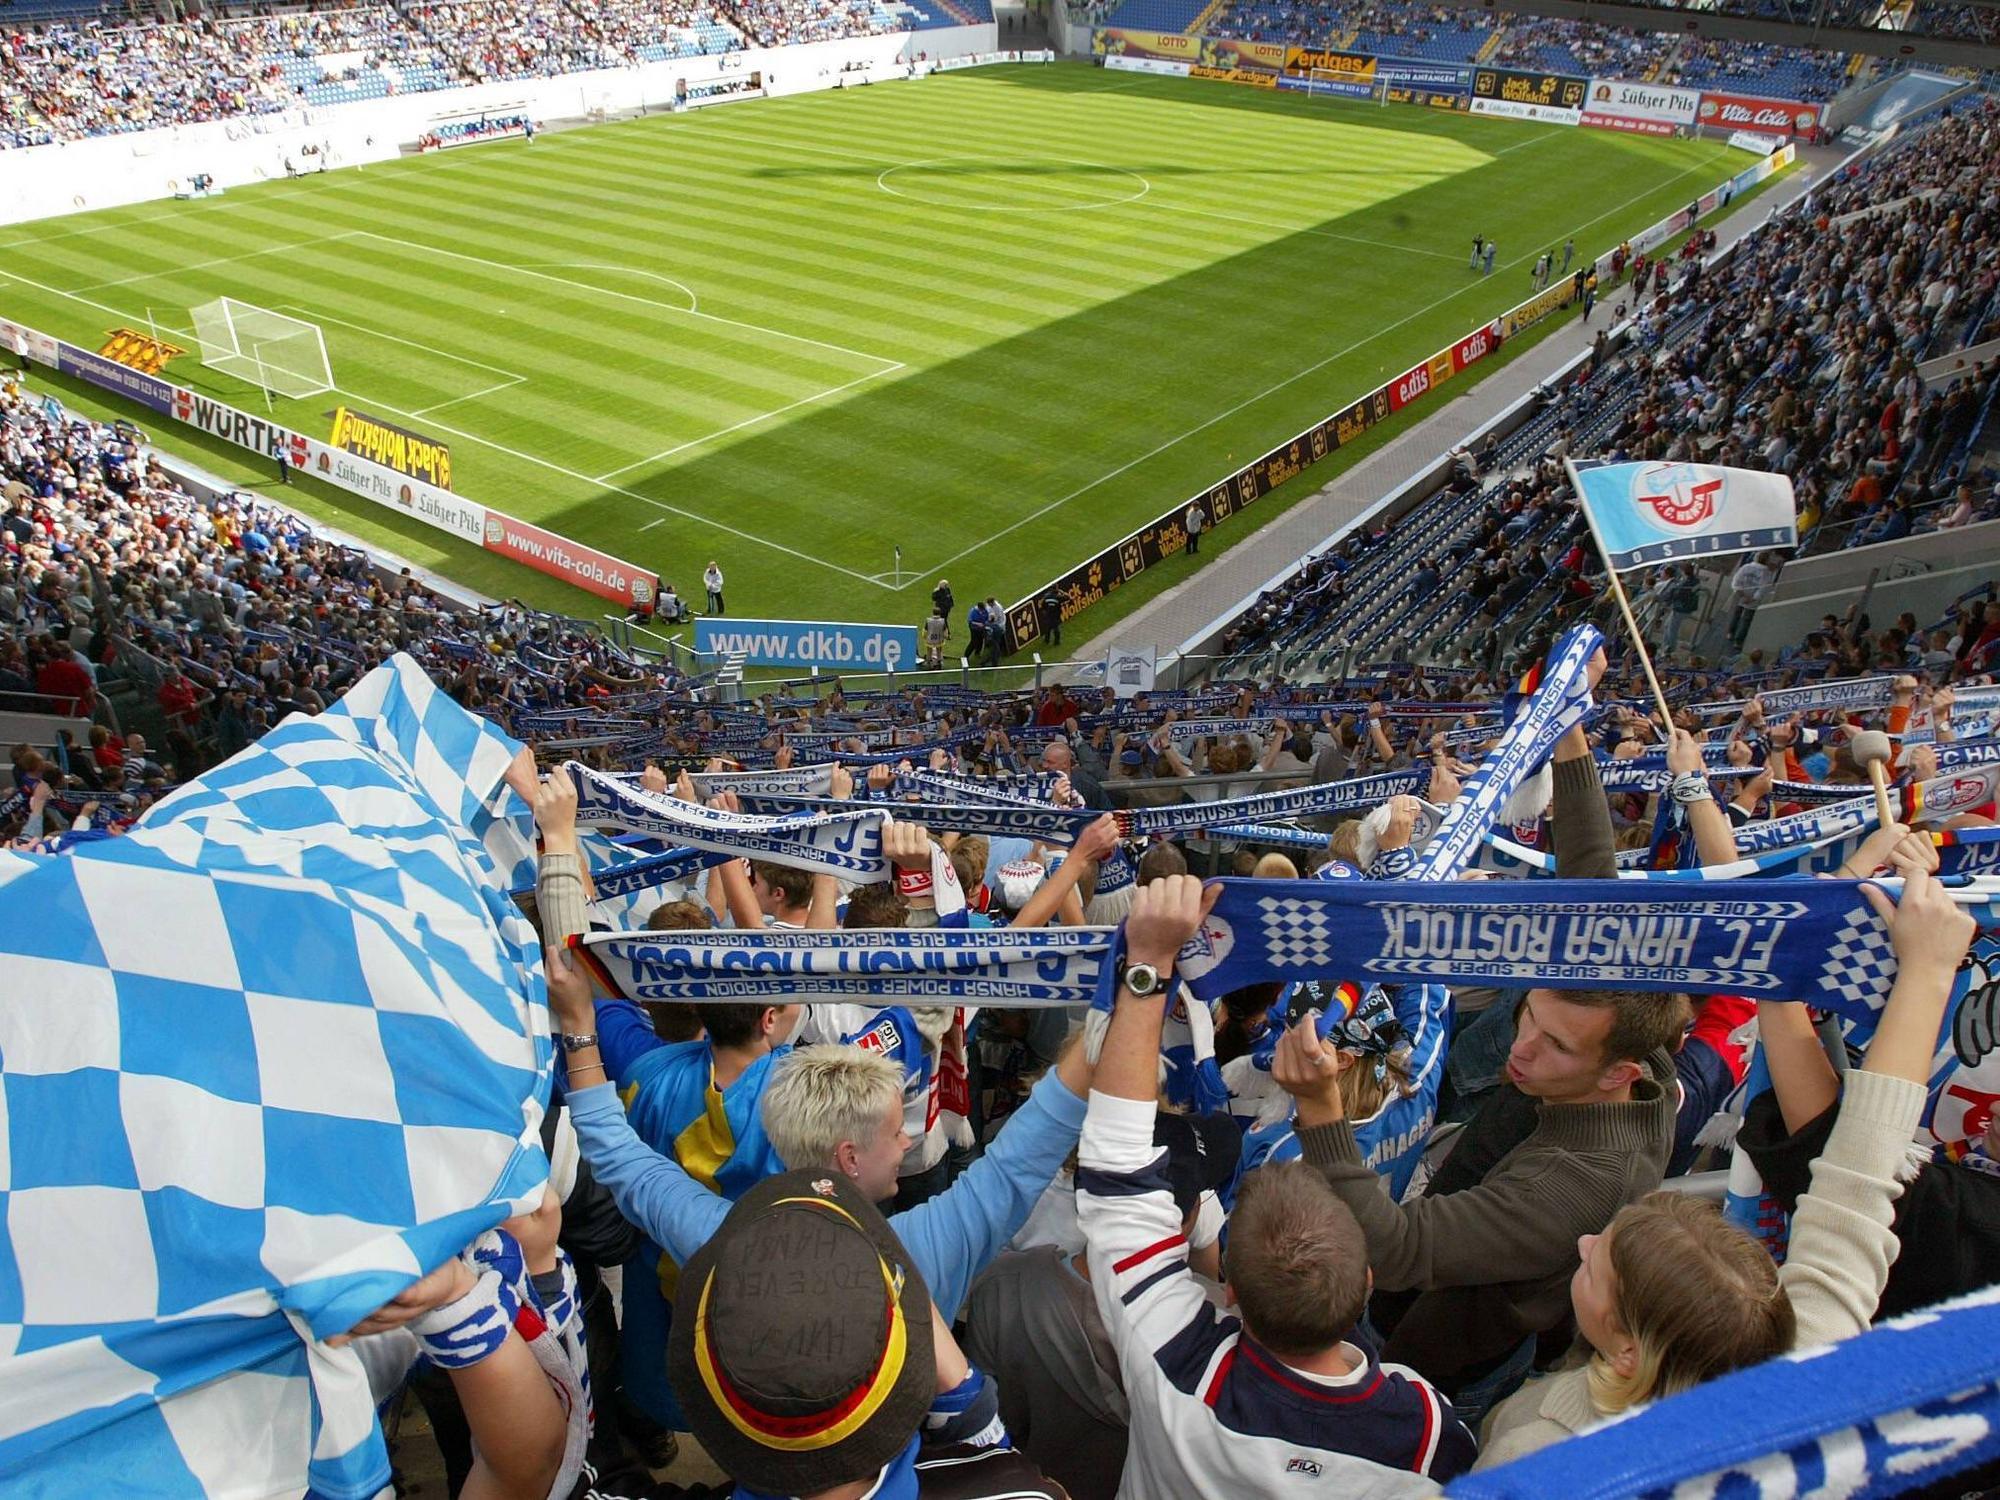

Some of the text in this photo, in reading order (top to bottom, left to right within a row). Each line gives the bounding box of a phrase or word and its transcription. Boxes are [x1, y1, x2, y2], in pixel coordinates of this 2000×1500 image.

[1157, 36, 1188, 49] LOTTO
[1255, 45, 1283, 57] LOTTO
[1193, 64, 1226, 79] erdgas
[1298, 50, 1363, 74] erdgas
[1237, 69, 1271, 84] erdgas
[1503, 77, 1531, 90] Jack
[1502, 88, 1550, 104] Wolfskin
[1618, 88, 1694, 111] Lübzer Pils
[1721, 103, 1791, 127] Vita Cola
[1462, 333, 1488, 365] e.dis
[1399, 369, 1429, 403] e.dis
[193, 396, 286, 460] WÜRTH
[1267, 457, 1286, 477] Jack
[1268, 463, 1301, 489] Wolfskin
[371, 474, 392, 499] Pils
[1676, 493, 1706, 521] HANSA
[458, 508, 480, 535] Pils
[1158, 521, 1180, 546] Jack
[506, 528, 626, 593] www.vita-cola.de
[1059, 586, 1104, 622] Wolfskin
[708, 630, 902, 663] www.dkb.de
[663, 759, 711, 768] POW
[1965, 745, 2000, 763] HA
[1446, 677, 1566, 855] STARK SUPER HANSA
[1005, 776, 1057, 790] ROSTO
[1600, 766, 1674, 791] ikings
[710, 783, 810, 796] ROSTOCK
[1139, 811, 1172, 829] EIN
[1362, 777, 1419, 799] HANSA
[926, 819, 982, 831] WALK
[929, 808, 1080, 832] ROSTOCK
[1247, 824, 1293, 838] NOCH
[1298, 831, 1329, 843] WIE
[1735, 818, 1822, 854] HANS
[714, 833, 771, 851] POWER
[780, 843, 828, 862] HANSA
[653, 857, 707, 881] F.C.
[1101, 860, 1127, 875] ANSA
[1099, 869, 1130, 888] STOCK
[1598, 901, 1637, 914] VOM
[1646, 901, 1706, 916] FANS
[1714, 903, 1747, 917] DIE
[763, 933, 896, 948] MECKLENBURG
[909, 932, 947, 947] AUS
[961, 932, 1031, 947] MACHT
[1045, 932, 1080, 946] DIE
[1379, 907, 1786, 972] F.C. HANSA ROSTOCK
[1450, 962, 1689, 982] SUPER SUPER SUPER
[704, 979, 1032, 998] HANSA POWER OSTSEE-STADION
[1289, 1459, 1318, 1474] FILA
